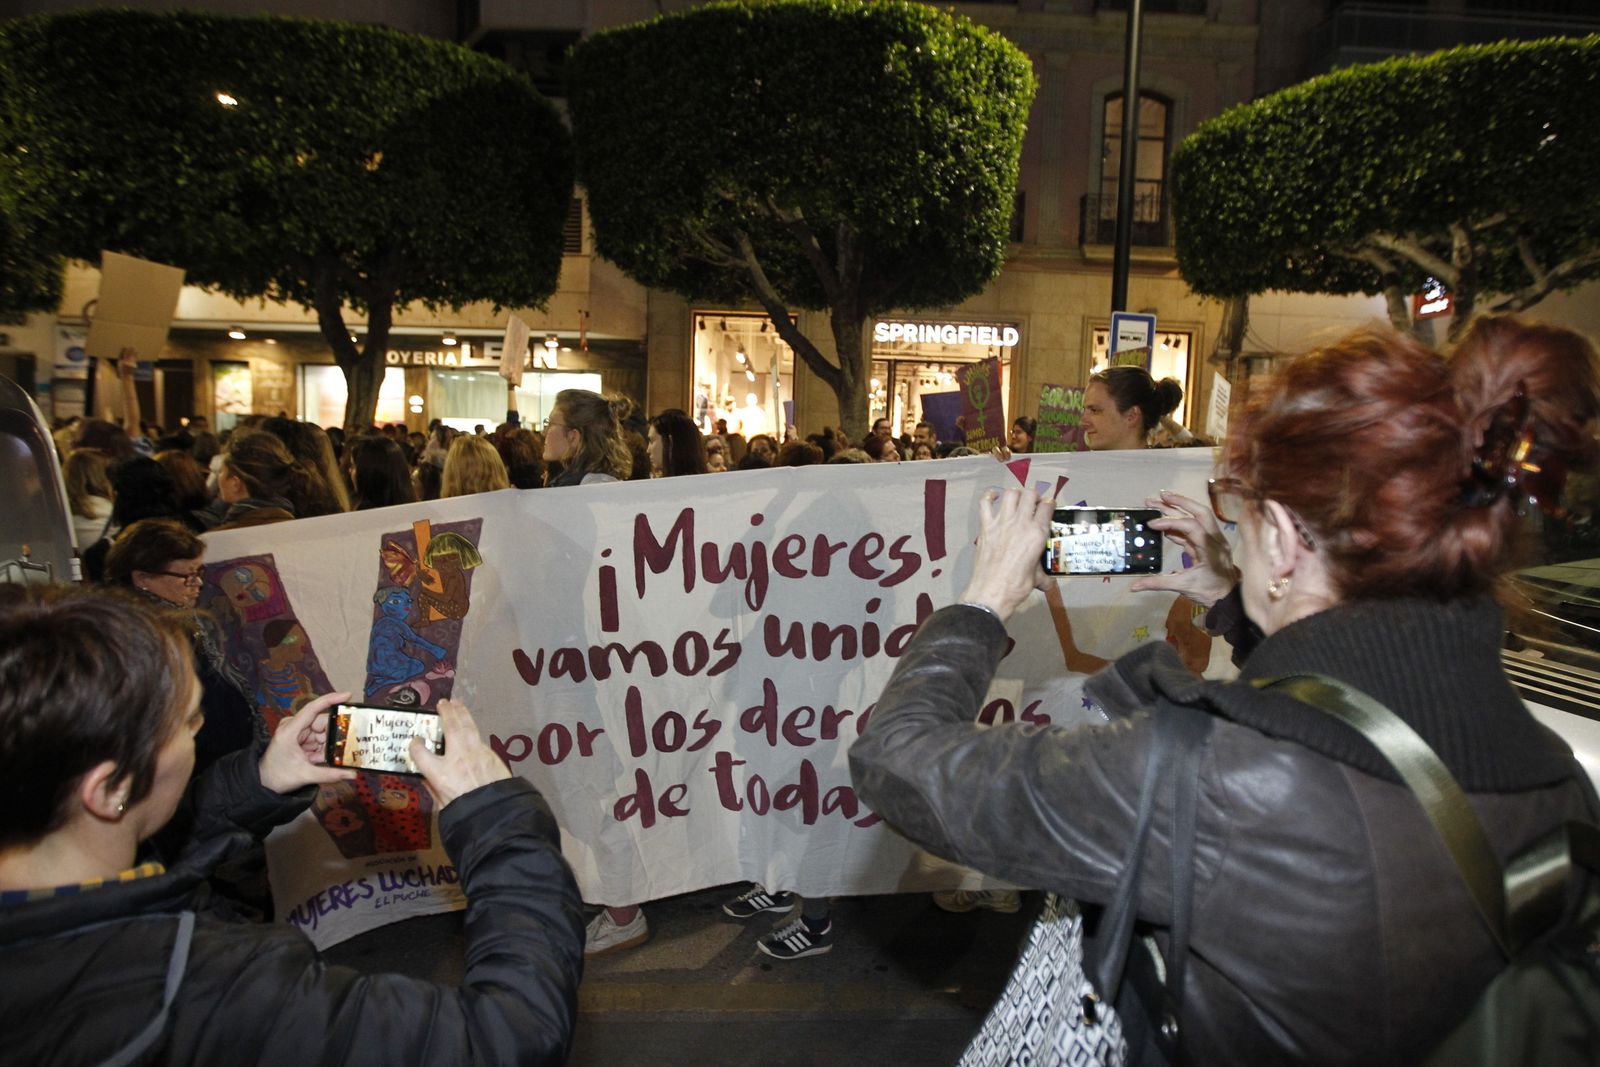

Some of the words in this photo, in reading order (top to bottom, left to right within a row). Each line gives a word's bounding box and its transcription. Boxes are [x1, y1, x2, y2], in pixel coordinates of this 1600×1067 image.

[386, 350, 458, 366] OYERIA
[460, 341, 558, 369] LEN
[874, 322, 1019, 346] SPRINGFIELD
[598, 479, 947, 632] ¡Mujeres!
[512, 628, 743, 686] vamos
[762, 592, 1016, 661] unid
[489, 722, 605, 777] por
[624, 684, 722, 758] los
[613, 768, 690, 828] de
[374, 897, 391, 909] EL
[392, 888, 431, 905] PUCHE
